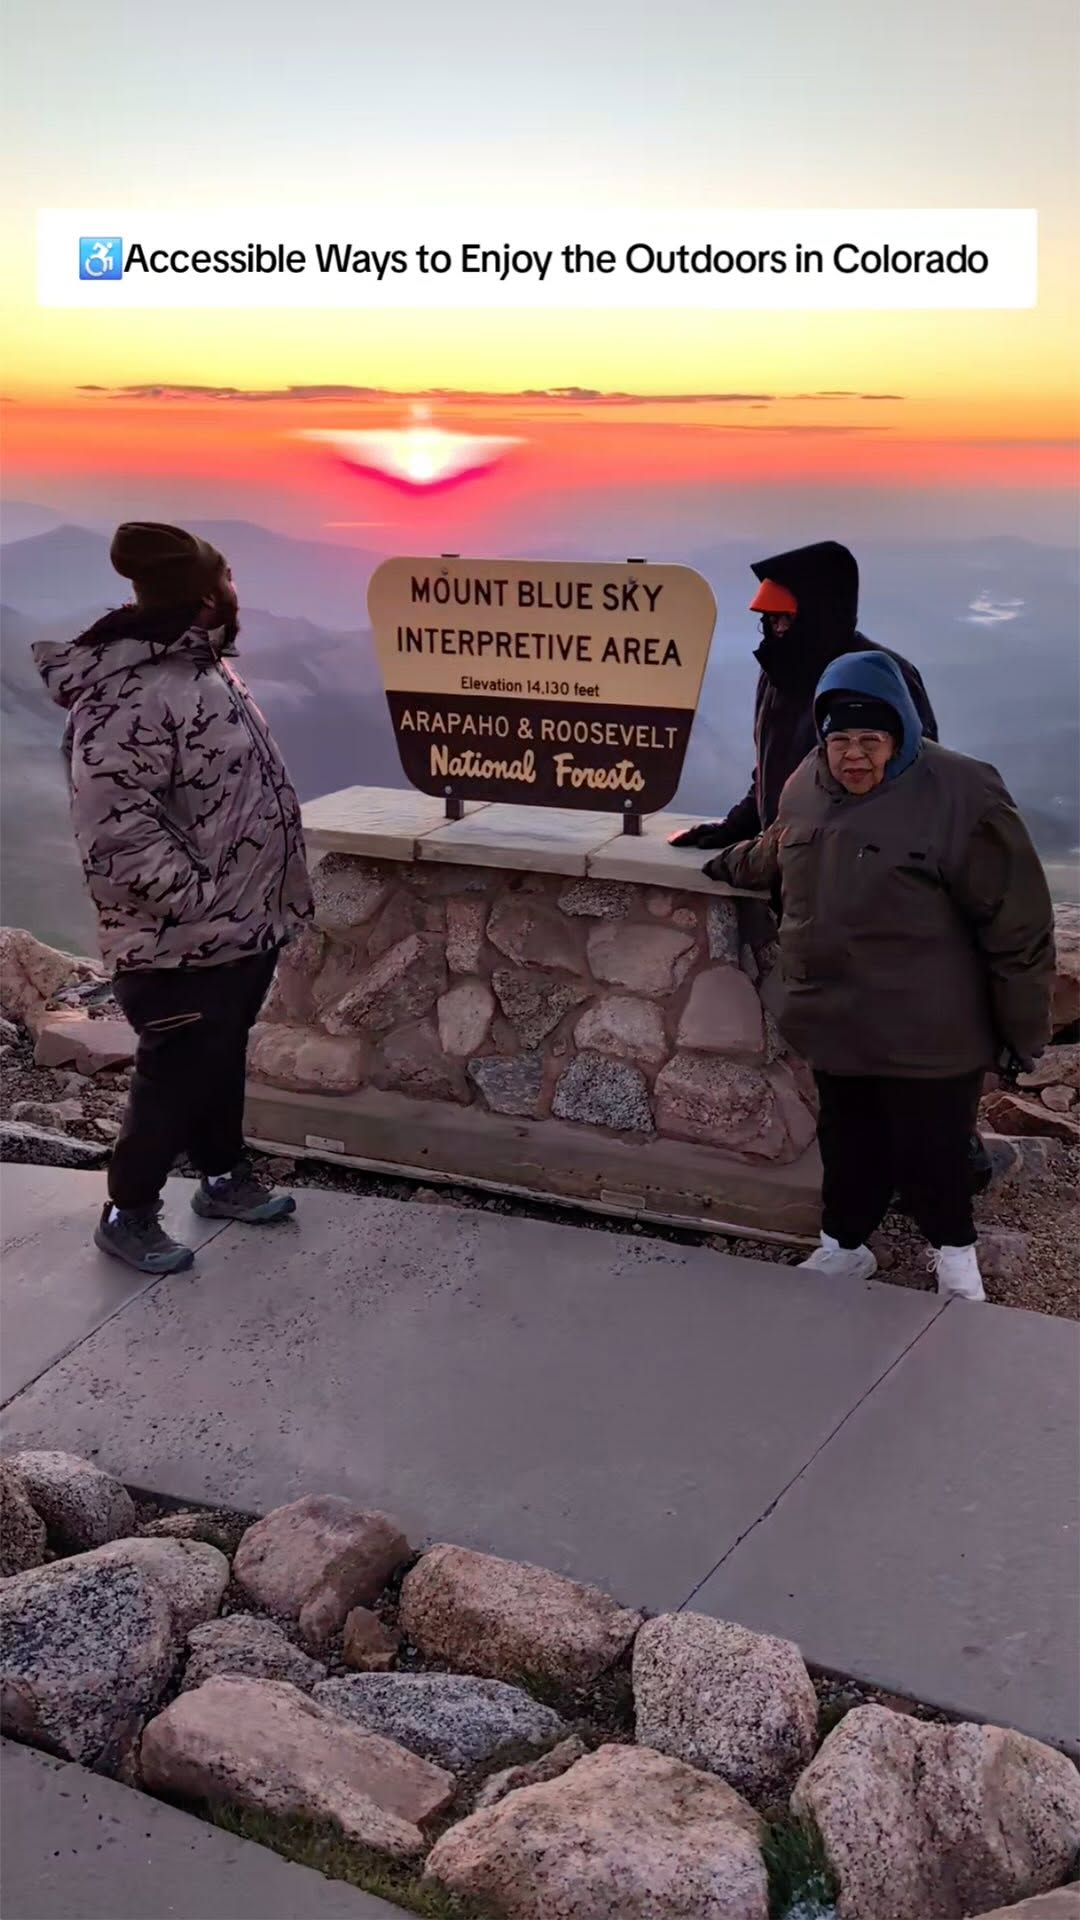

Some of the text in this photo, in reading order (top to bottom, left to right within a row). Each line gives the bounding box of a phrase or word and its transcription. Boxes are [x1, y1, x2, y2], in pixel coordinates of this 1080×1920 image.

[411, 576, 664, 612] MOUNT BLUE SKY
[397, 626, 682, 667] INTERPRETIVE AREA
[461, 676, 522, 693] Elevation
[574, 682, 600, 697] feet
[400, 710, 678, 749] ARAPAHO & ROOSEVELT
[430, 744, 646, 792] National Forests
